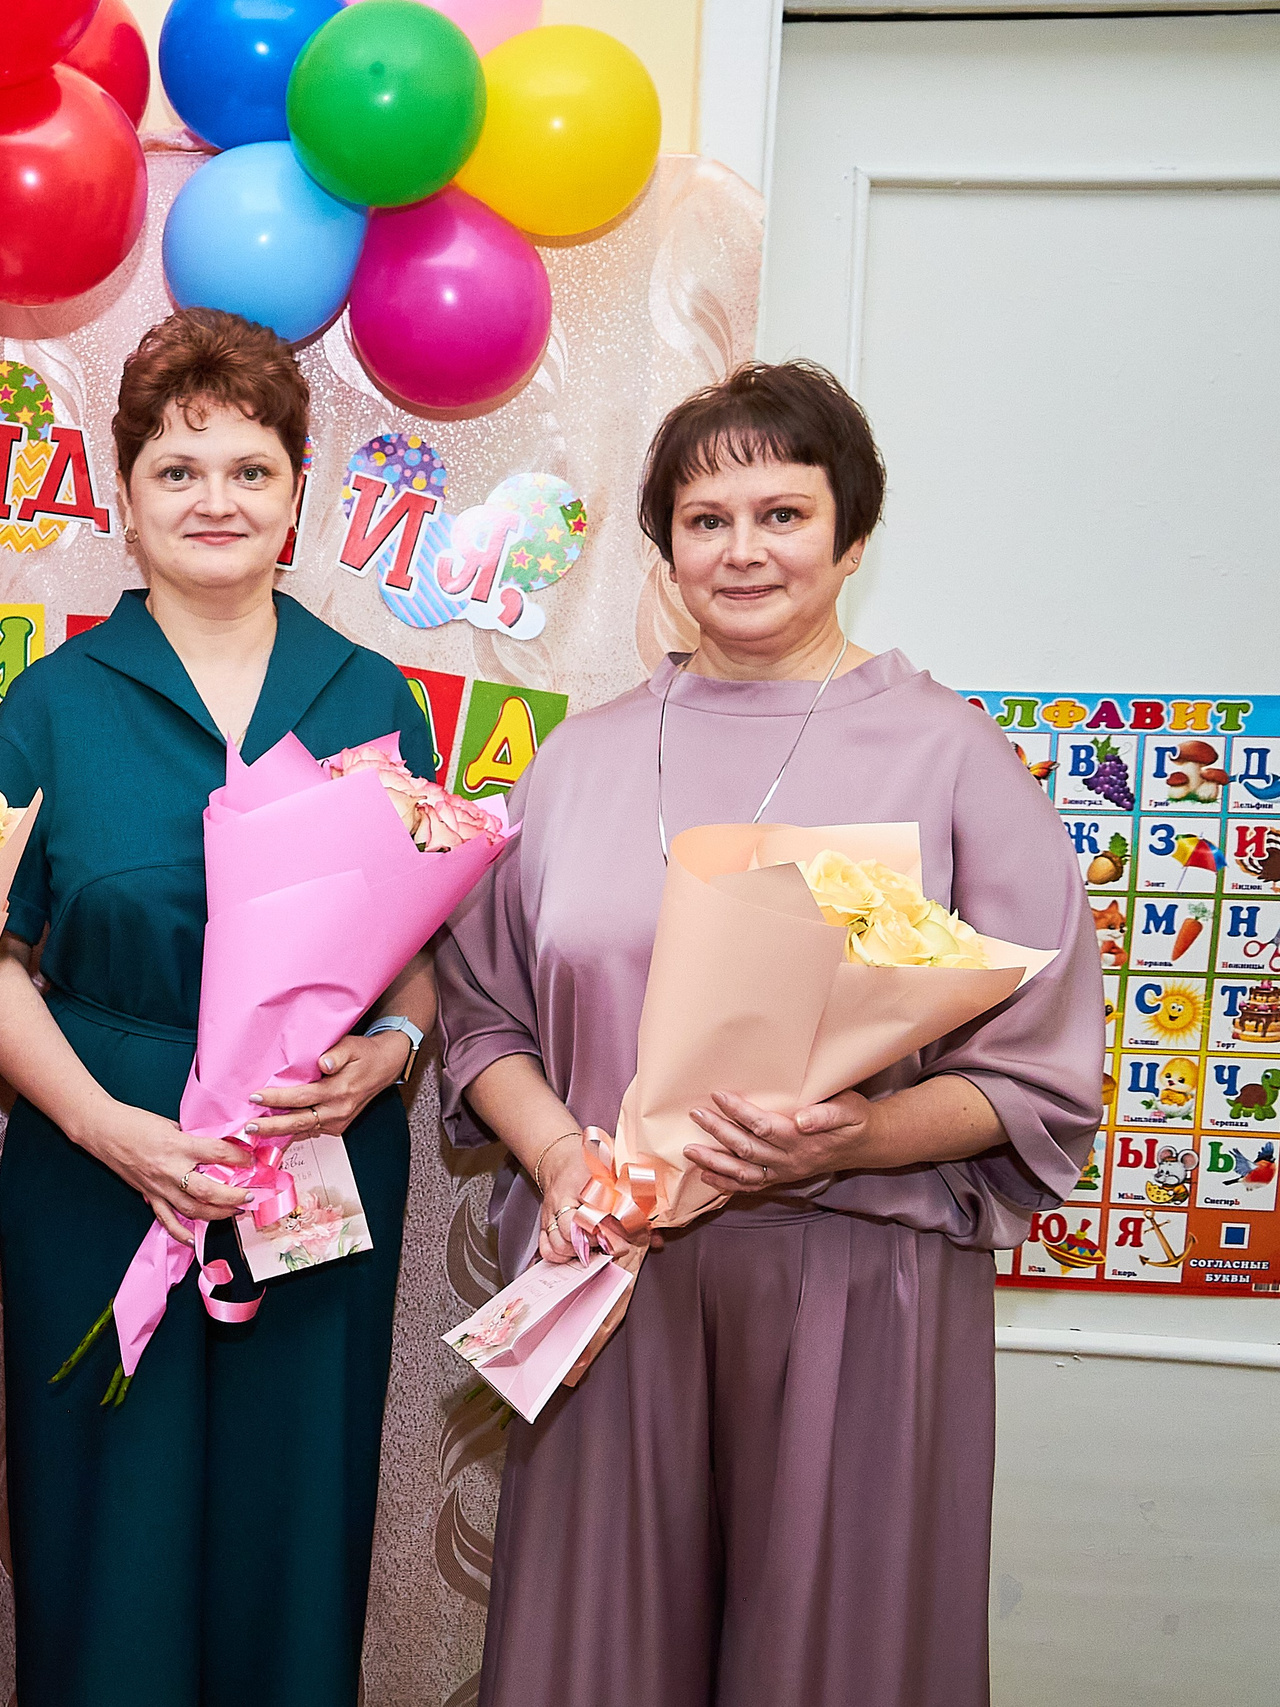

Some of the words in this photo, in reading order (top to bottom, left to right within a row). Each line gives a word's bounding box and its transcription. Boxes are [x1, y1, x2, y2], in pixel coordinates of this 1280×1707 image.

[968, 698, 1251, 731] ЛФАВИТ
[1069, 744, 1095, 777] В
[1153, 746, 1177, 778] Г
[1239, 747, 1271, 783] Д
[1062, 798, 1103, 806] Виноград
[1232, 801, 1274, 810] Дельфин
[1064, 821, 1100, 854] Ж
[1149, 823, 1176, 856] З
[1234, 825, 1269, 858] И
[1144, 880, 1166, 888] Зонт
[1231, 882, 1263, 891] Индюк
[1142, 903, 1178, 935] М
[1227, 905, 1261, 937] Н
[1136, 959, 1174, 968] Морковь
[1221, 960, 1265, 970] Ножницы
[1135, 982, 1162, 1015] С
[1221, 984, 1248, 1017] Т
[1216, 1040, 1236, 1050] Торт
[1128, 1061, 1160, 1097] Ц
[1213, 1064, 1241, 1096] Ч
[1209, 1118, 1249, 1128] Черепаха
[1117, 1137, 1159, 1169] Ы
[1206, 1141, 1234, 1173] Ь
[1028, 1212, 1068, 1244] Ю
[1115, 1216, 1145, 1247] Я
[1027, 1265, 1046, 1273] Юла
[1111, 1268, 1137, 1278] Якорь
[1189, 1258, 1270, 1270] СОГЛАСНЫЕ
[1205, 1273, 1251, 1283] БУКВЫ
